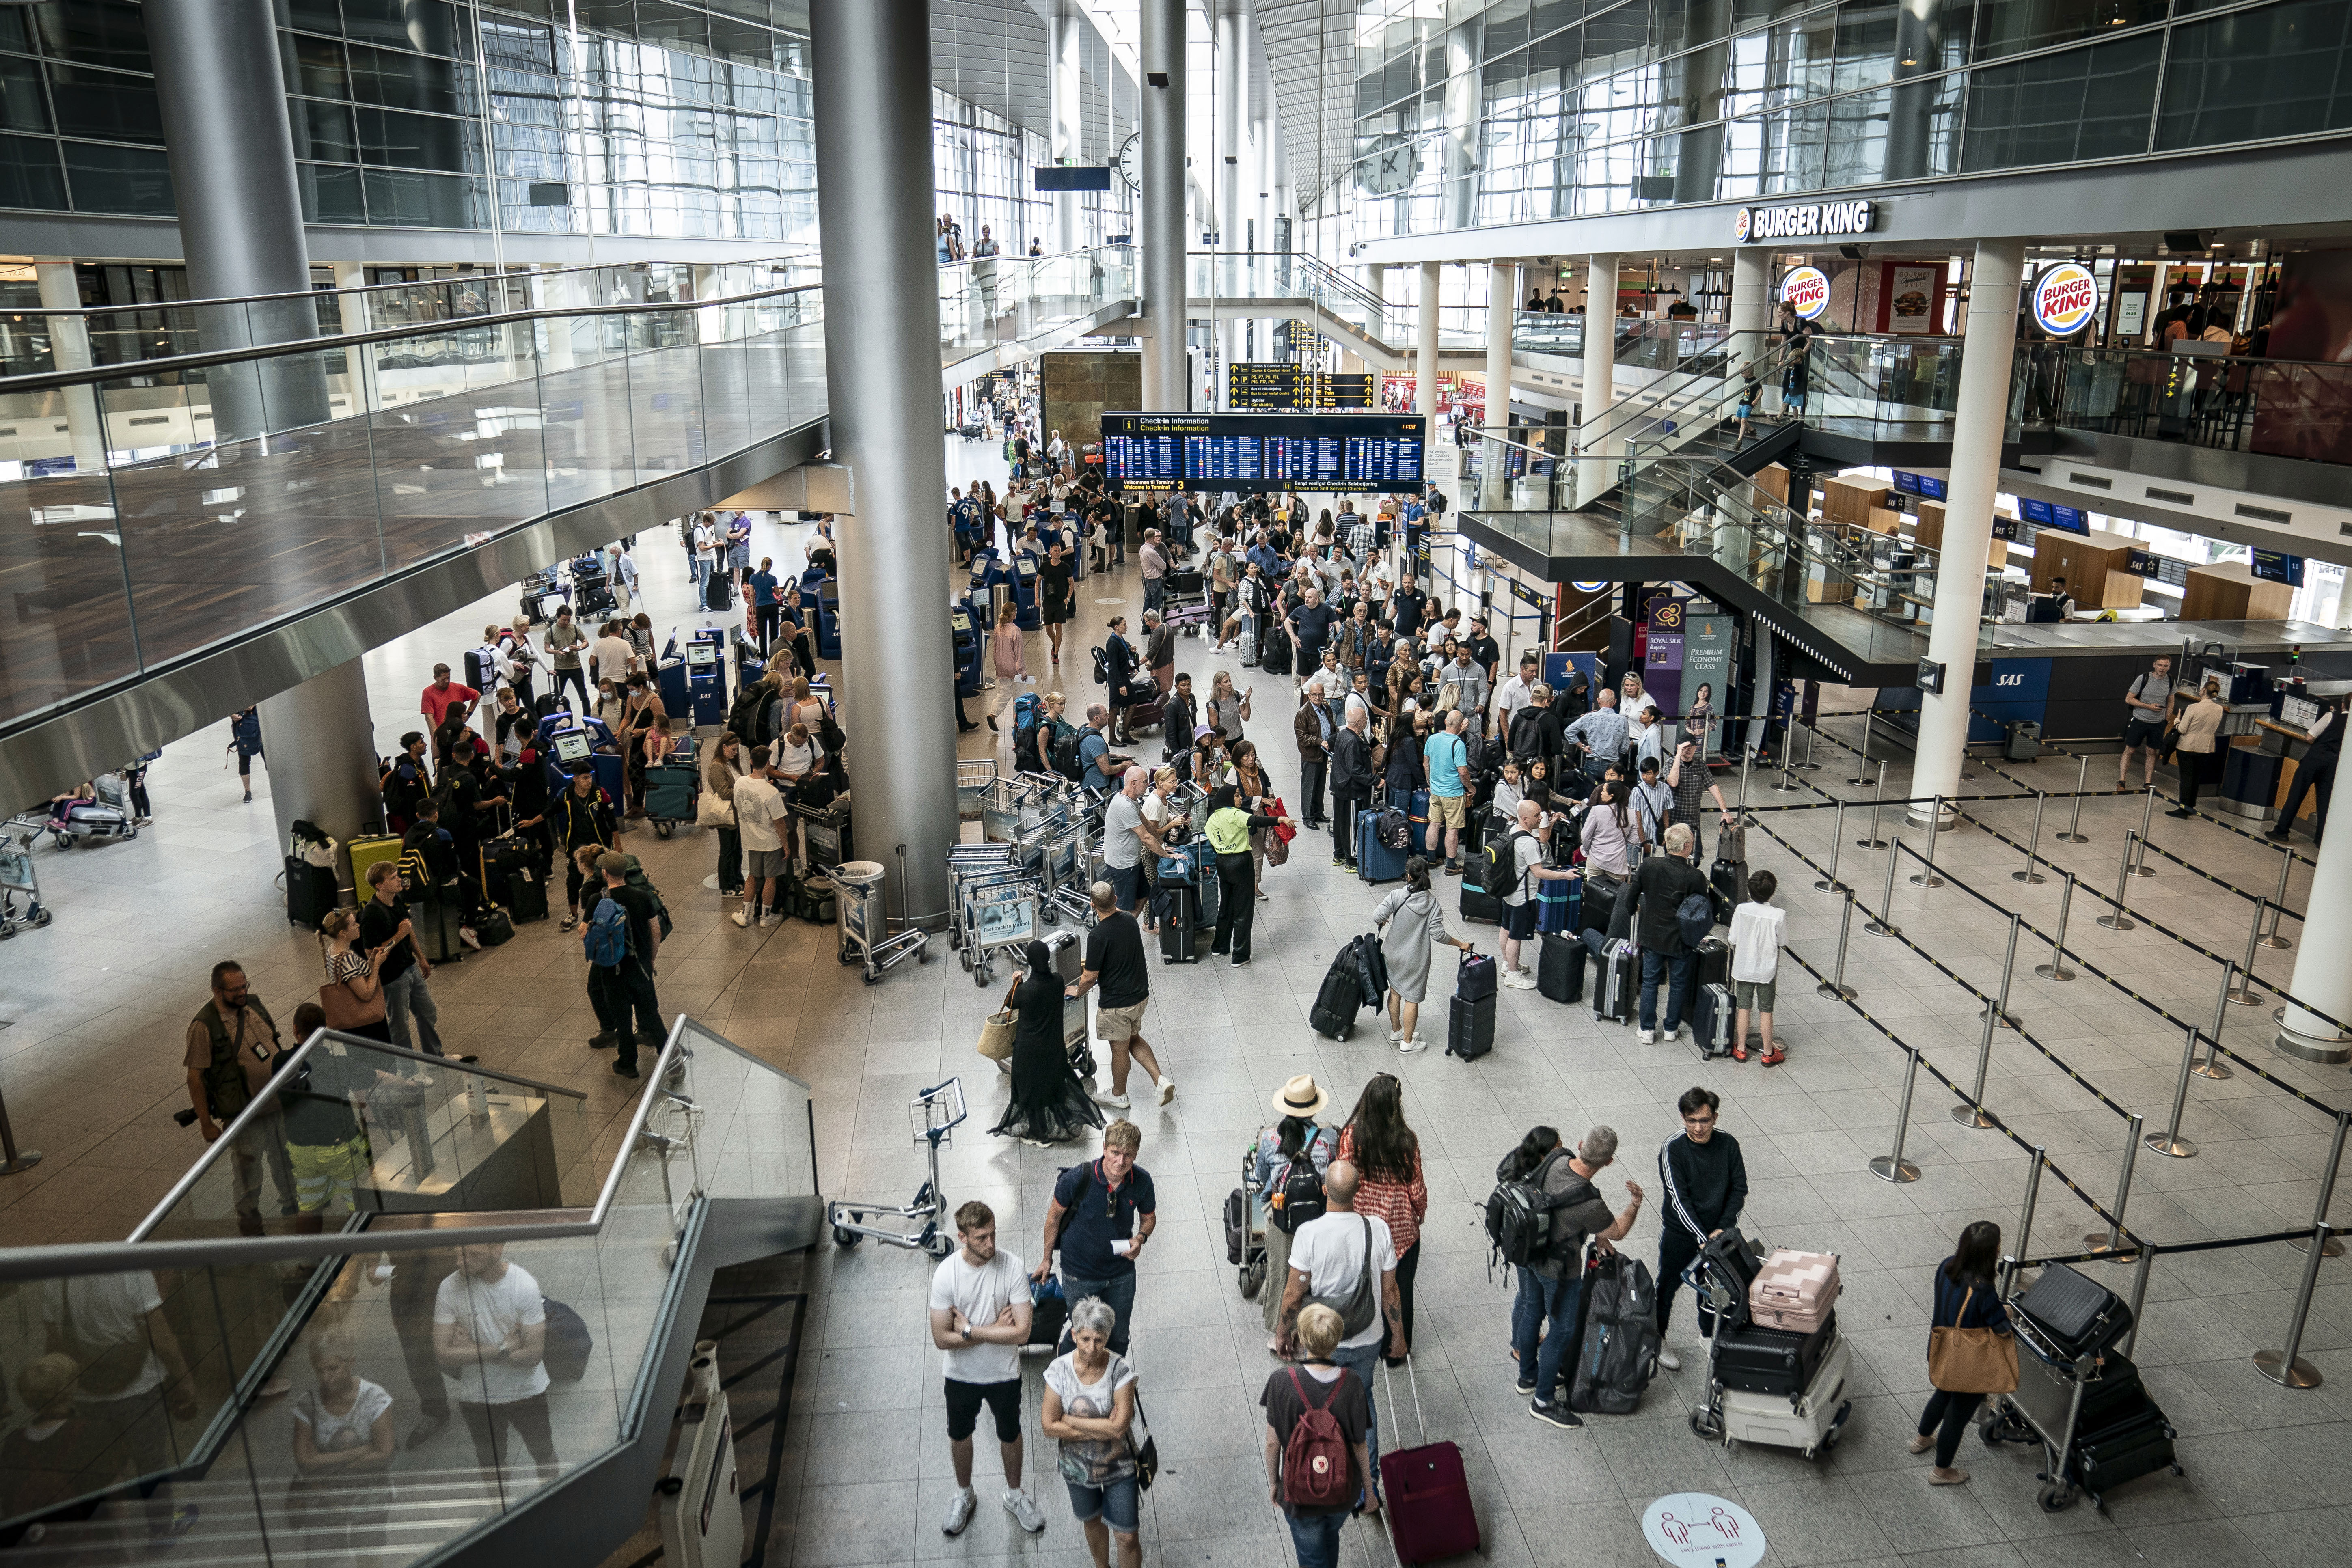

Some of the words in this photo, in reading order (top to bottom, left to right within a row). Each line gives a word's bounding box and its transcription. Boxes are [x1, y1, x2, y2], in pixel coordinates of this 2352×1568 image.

[1754, 205, 1819, 238] BURGER
[1821, 201, 1869, 234] KING
[1788, 278, 1823, 295] BURGER
[2043, 279, 2090, 302] BURGER
[1789, 287, 1824, 306] KING
[2043, 291, 2091, 318] KING
[1177, 481, 1184, 490] 3
[962, 507, 968, 519] 9
[2130, 561, 2144, 570] SAS
[1996, 674, 2024, 686] SAS
